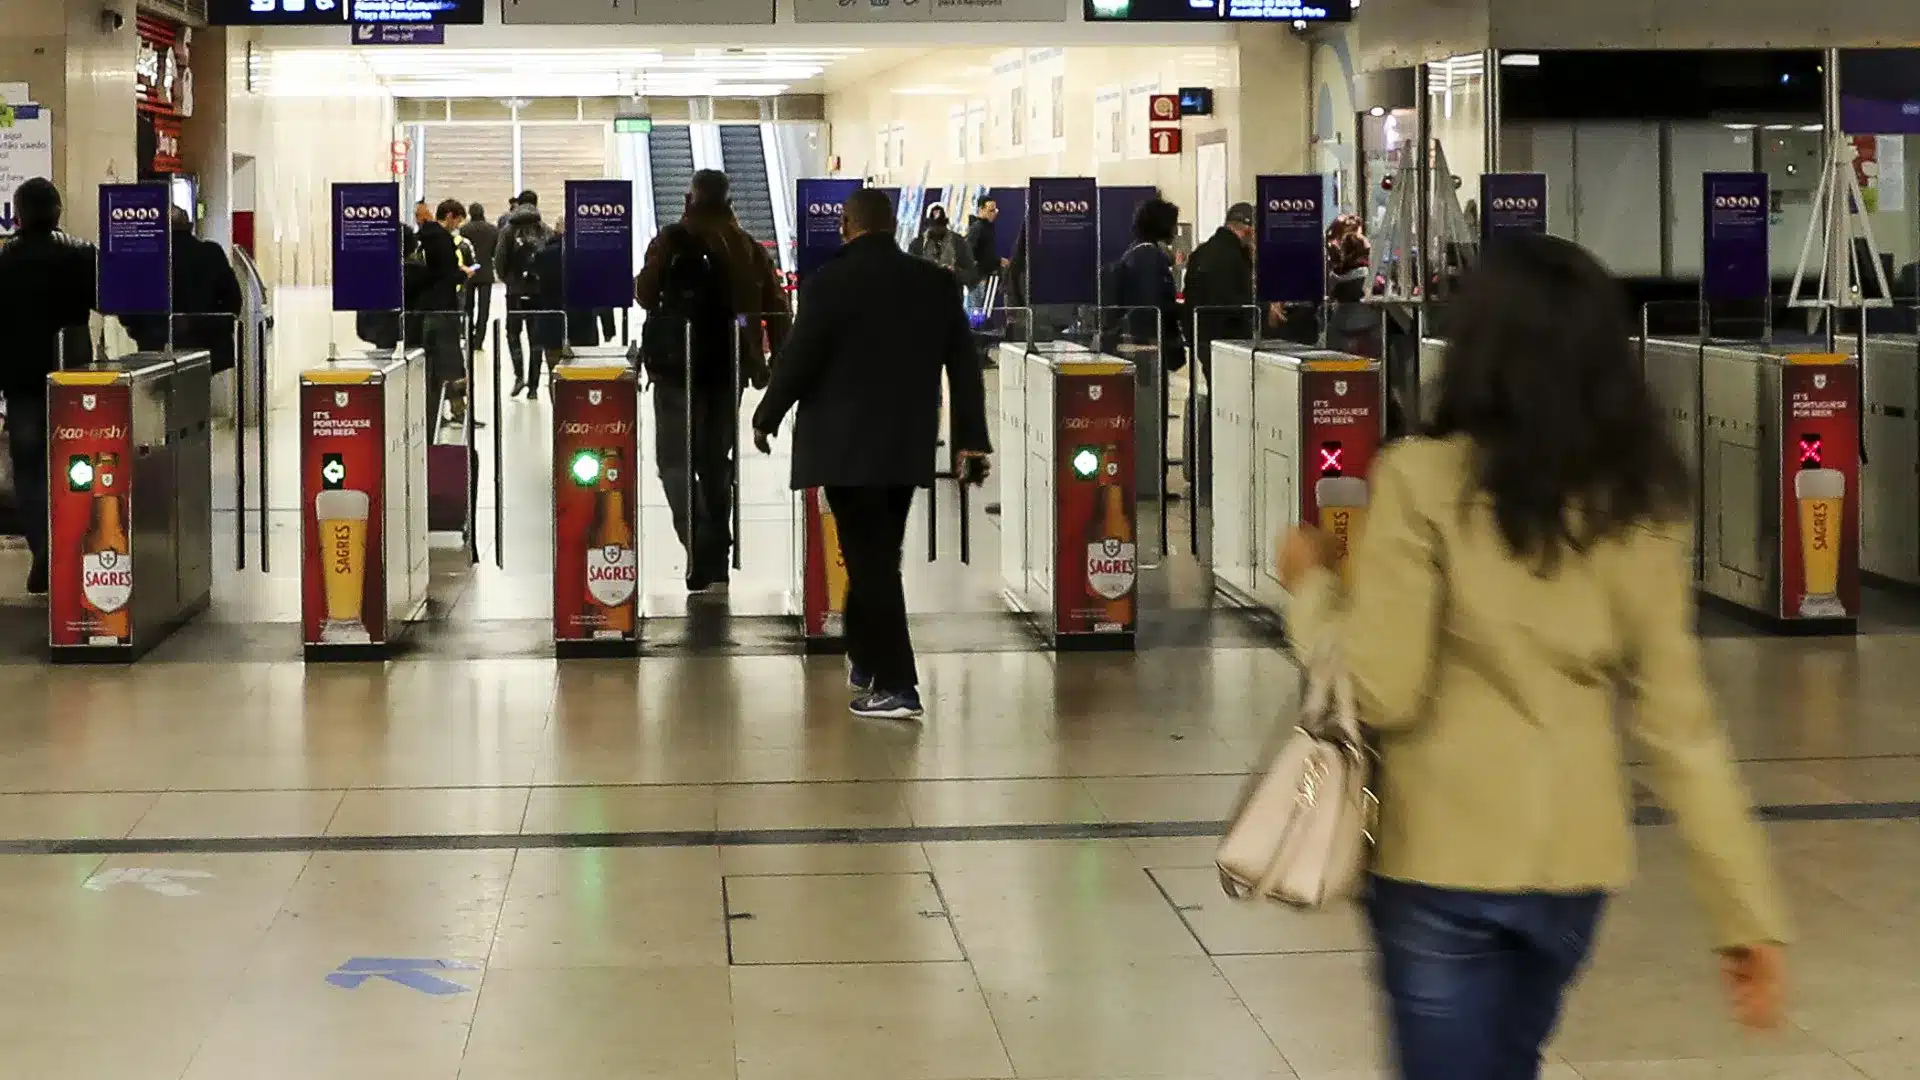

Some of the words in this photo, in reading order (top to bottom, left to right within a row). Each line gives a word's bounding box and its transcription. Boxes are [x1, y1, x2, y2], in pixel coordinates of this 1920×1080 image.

[313, 419, 371, 428] PORTUGUESE
[313, 428, 332, 437] FOR
[1812, 502, 1828, 551] SAGRES
[335, 524, 351, 575] SAGRES
[589, 564, 636, 582] SAGRES
[1088, 558, 1134, 574] SAGRES
[85, 571, 132, 587] SAGRES
